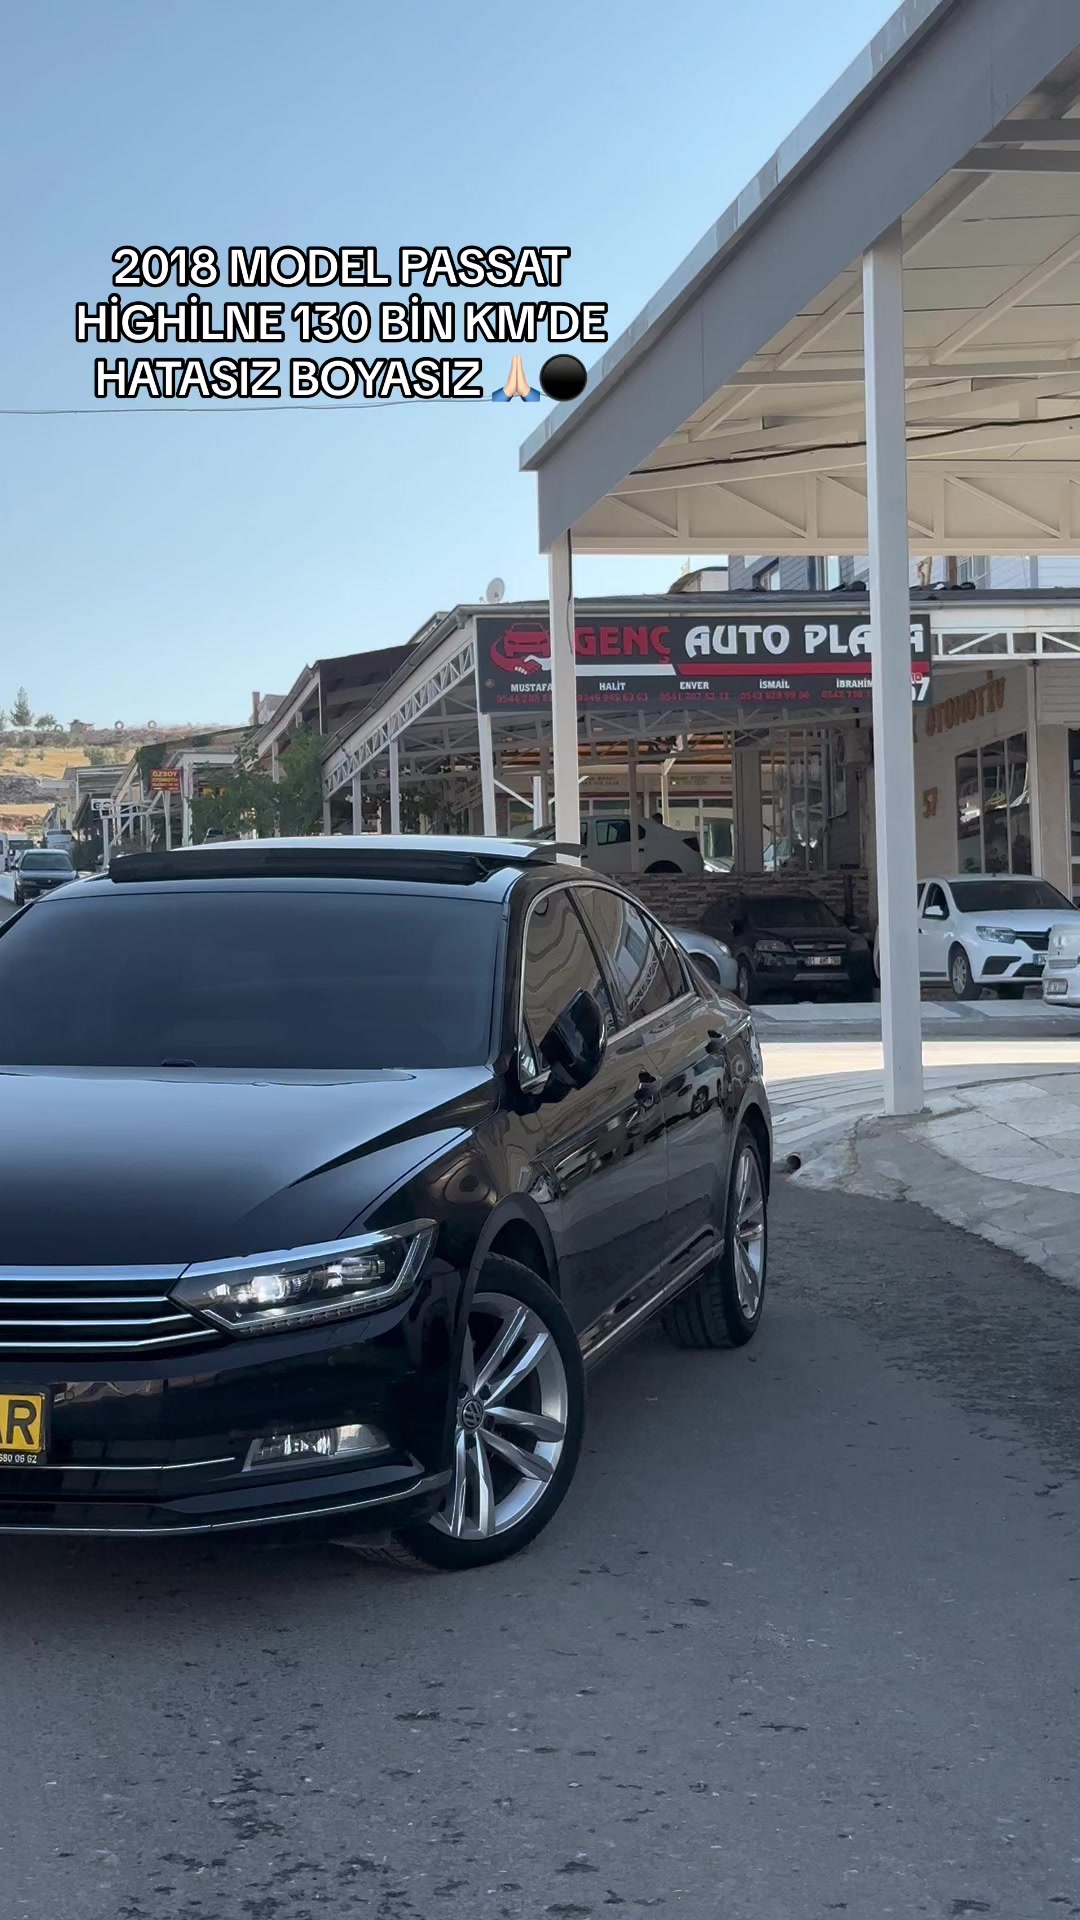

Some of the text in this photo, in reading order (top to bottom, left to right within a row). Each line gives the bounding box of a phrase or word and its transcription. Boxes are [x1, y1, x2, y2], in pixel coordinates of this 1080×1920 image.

[574, 624, 924, 664] GENÇ AUTO PLAA
[599, 681, 626, 691] HALİT
[679, 681, 710, 690] ENVER
[759, 679, 790, 689] İSMAİL
[0, 1400, 37, 1444] R
[27, 1454, 37, 1464] 62
